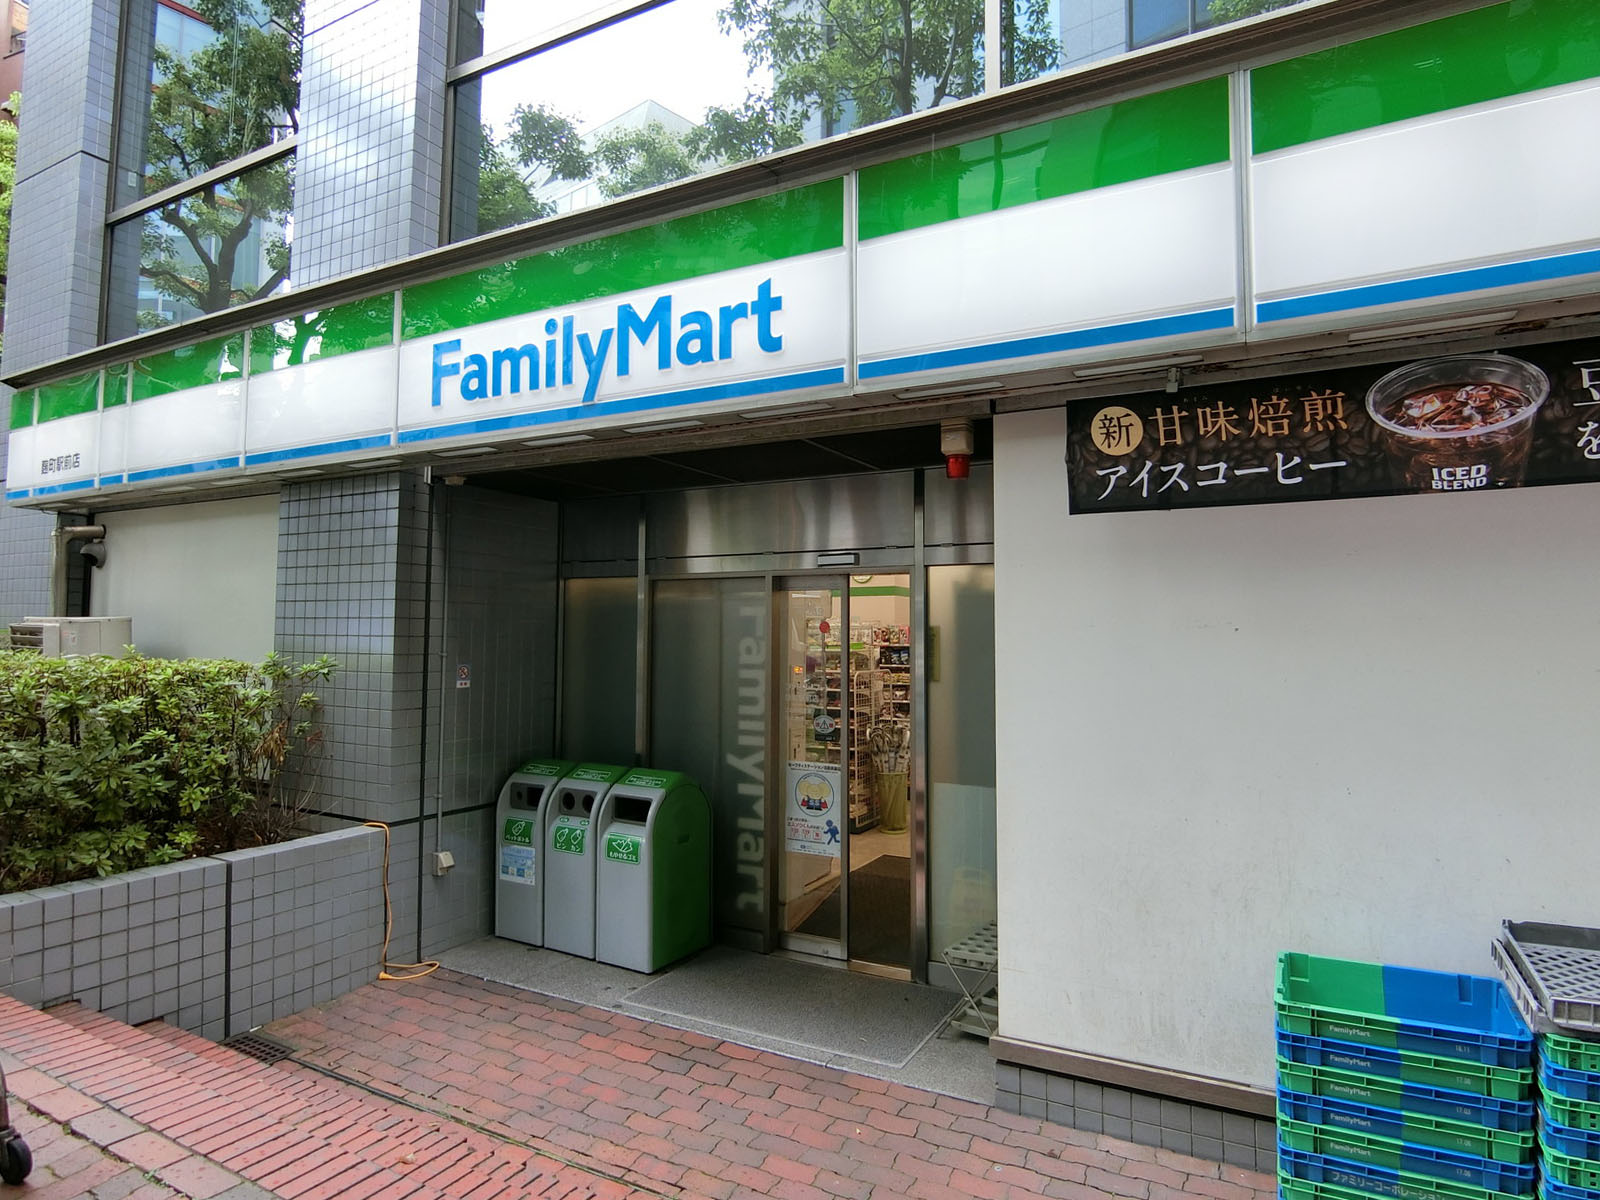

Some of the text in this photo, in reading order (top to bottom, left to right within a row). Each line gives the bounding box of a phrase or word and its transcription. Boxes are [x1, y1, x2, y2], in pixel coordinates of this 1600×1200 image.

[432, 278, 783, 405] FamilyMart
[1098, 388, 1350, 449] 新 甘味焙煎
[1095, 452, 1349, 501] アイスコーヒー
[1431, 464, 1487, 481] ICED
[1431, 477, 1488, 490] BLEND
[726, 605, 767, 914] FamilyMart
[1329, 1024, 1371, 1038] FamilyMart
[1330, 1083, 1371, 1097] FamilyMart
